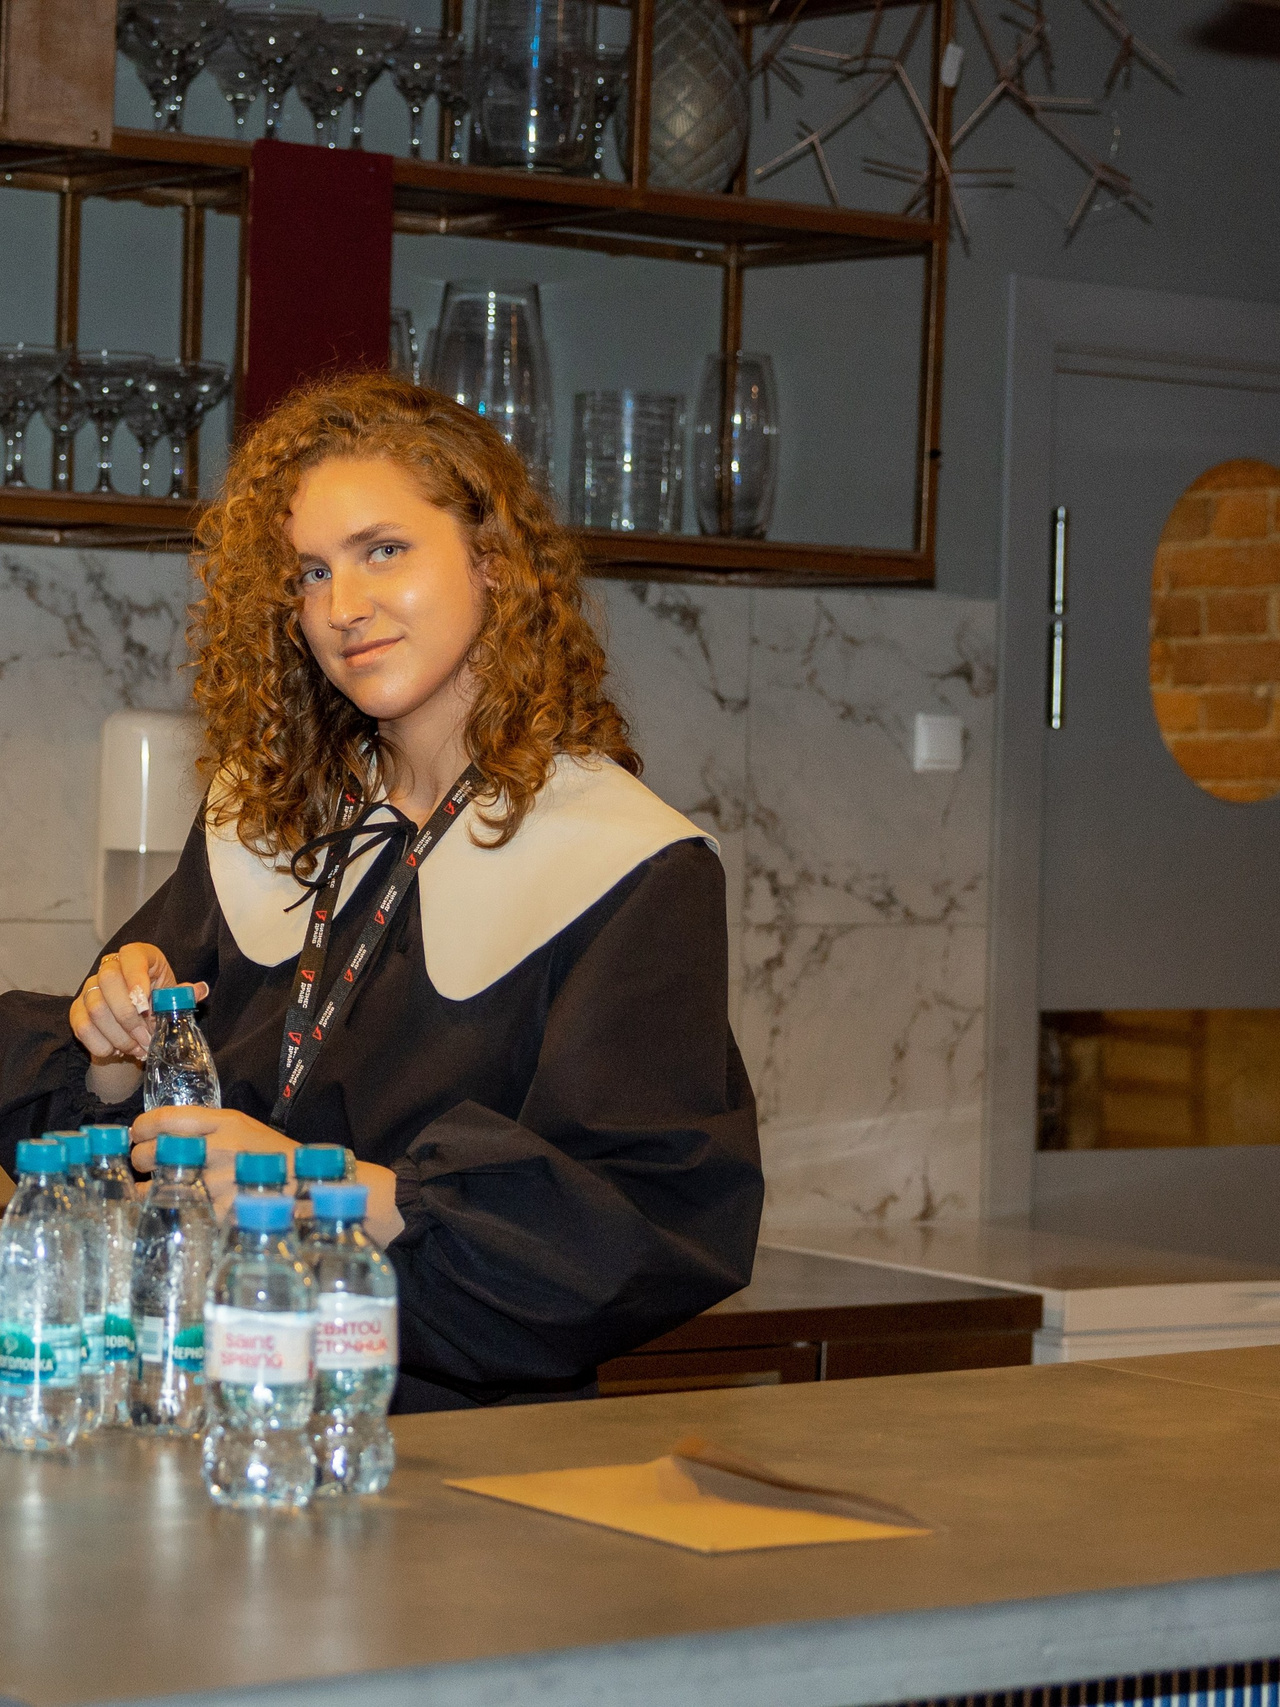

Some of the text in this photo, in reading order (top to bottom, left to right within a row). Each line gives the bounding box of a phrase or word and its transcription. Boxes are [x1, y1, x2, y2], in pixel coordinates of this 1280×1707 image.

[413, 830, 432, 853] БИЗНЕС
[417, 836, 433, 855] ДРАЙВ
[380, 885, 396, 910] БИЗНЕС
[384, 890, 398, 912] ДРАЙВ
[311, 922, 320, 945] ДРАЙВ
[315, 923, 325, 948] БИЗНЕС
[350, 943, 366, 968] БИЗНЕС
[353, 949, 367, 970] ДРАЙВ
[297, 982, 307, 1004] ДРАЙВ
[302, 983, 312, 1009] БИЗНЕС
[318, 1001, 334, 1025] БИЗНЕС
[322, 1006, 335, 1028] ДРАЙВ
[286, 1045, 294, 1068] ДРАЙВ
[288, 1059, 303, 1084] БИЗНЕС
[291, 1064, 305, 1086] ДРАЙВ
